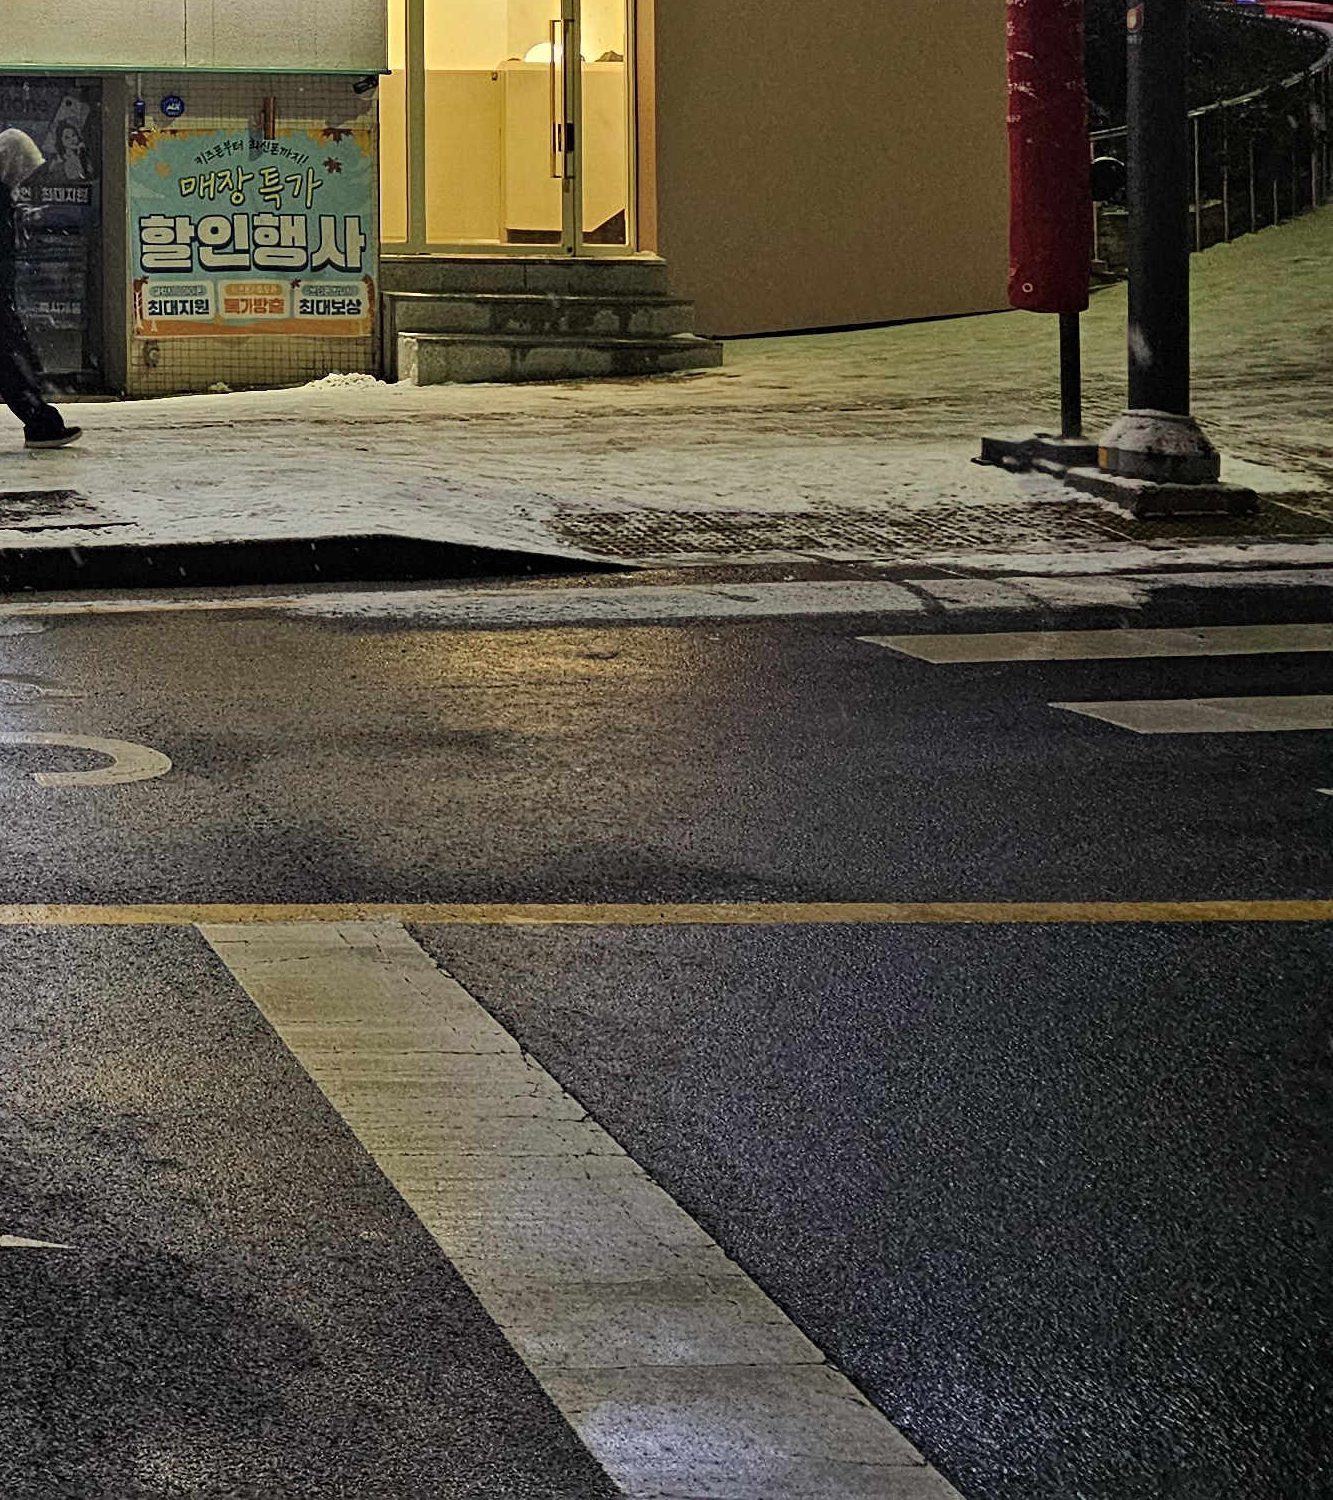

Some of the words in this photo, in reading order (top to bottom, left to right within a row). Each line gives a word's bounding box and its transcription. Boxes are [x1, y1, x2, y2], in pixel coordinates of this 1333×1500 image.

[194, 139, 245, 166] 키즈폰부터
[247, 139, 310, 167] 최신폰까지!
[179, 166, 255, 206] 매장
[258, 166, 324, 210] 특가
[139, 212, 367, 274] 할인행사
[147, 299, 210, 316] 최대지원
[223, 298, 286, 315] 특가방출
[299, 299, 363, 316] 최대보상
